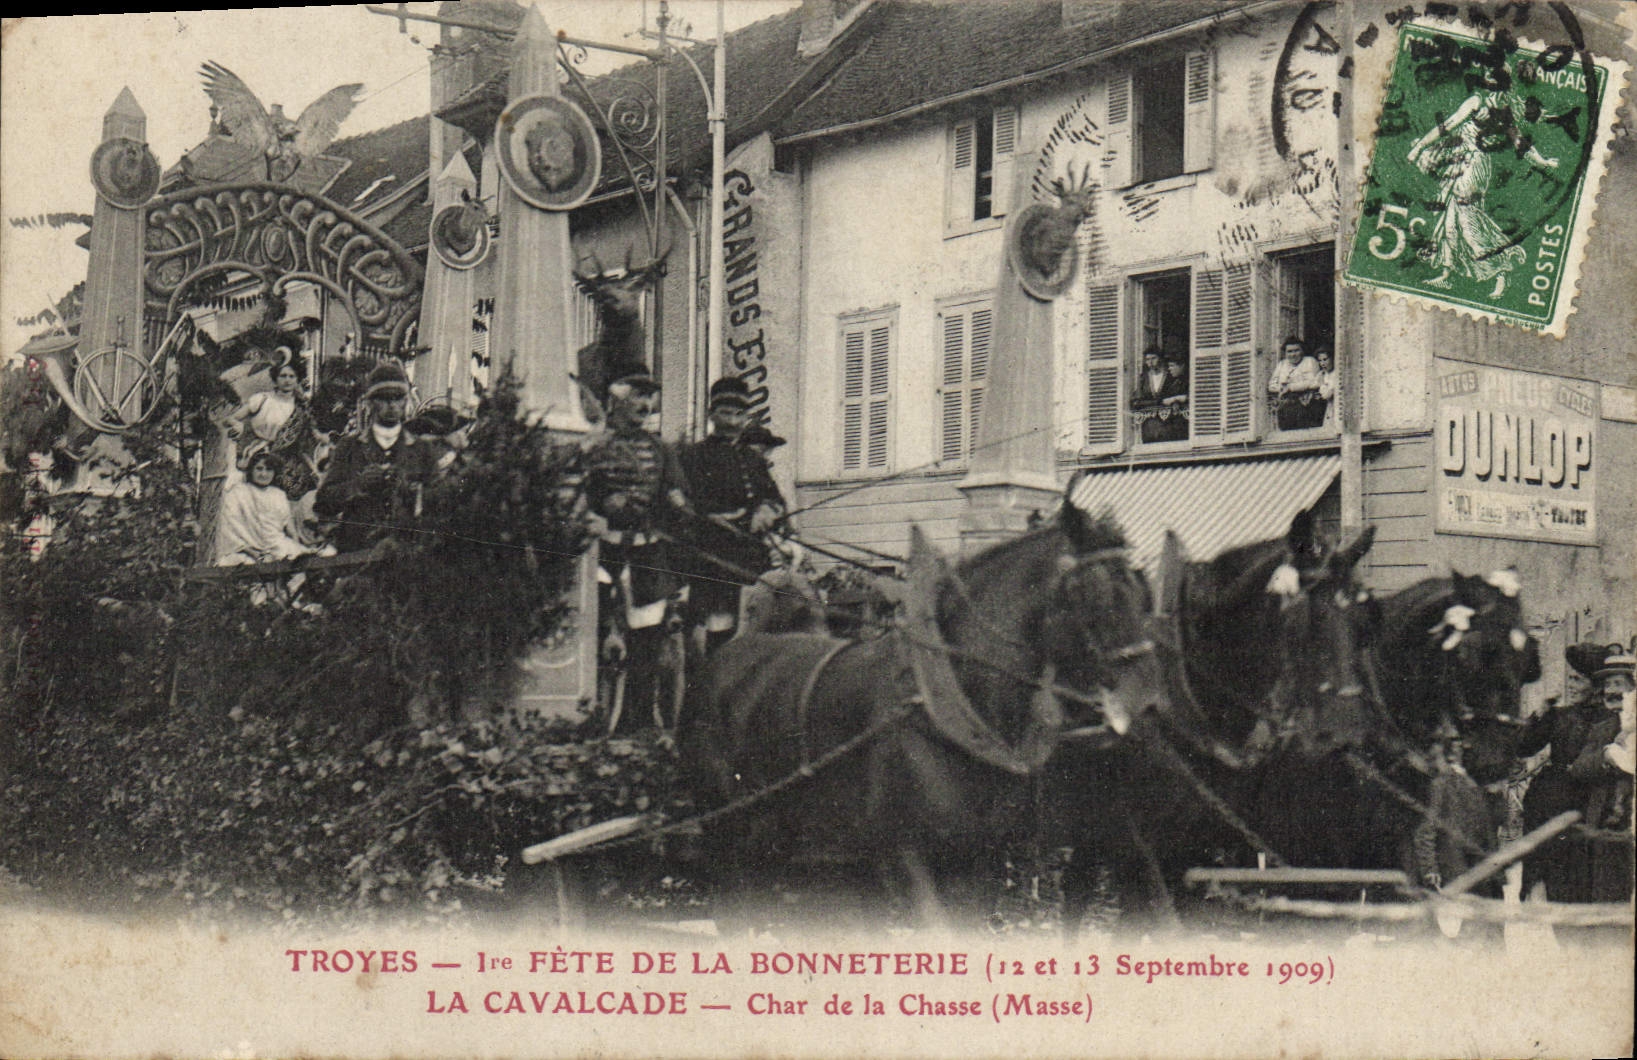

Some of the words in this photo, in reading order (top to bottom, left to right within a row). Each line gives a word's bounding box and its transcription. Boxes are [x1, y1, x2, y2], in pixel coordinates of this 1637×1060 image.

[722, 168, 762, 327] GRANDS
[1527, 223, 1564, 307] POSTES
[1441, 405, 1593, 489] DUNLOP
